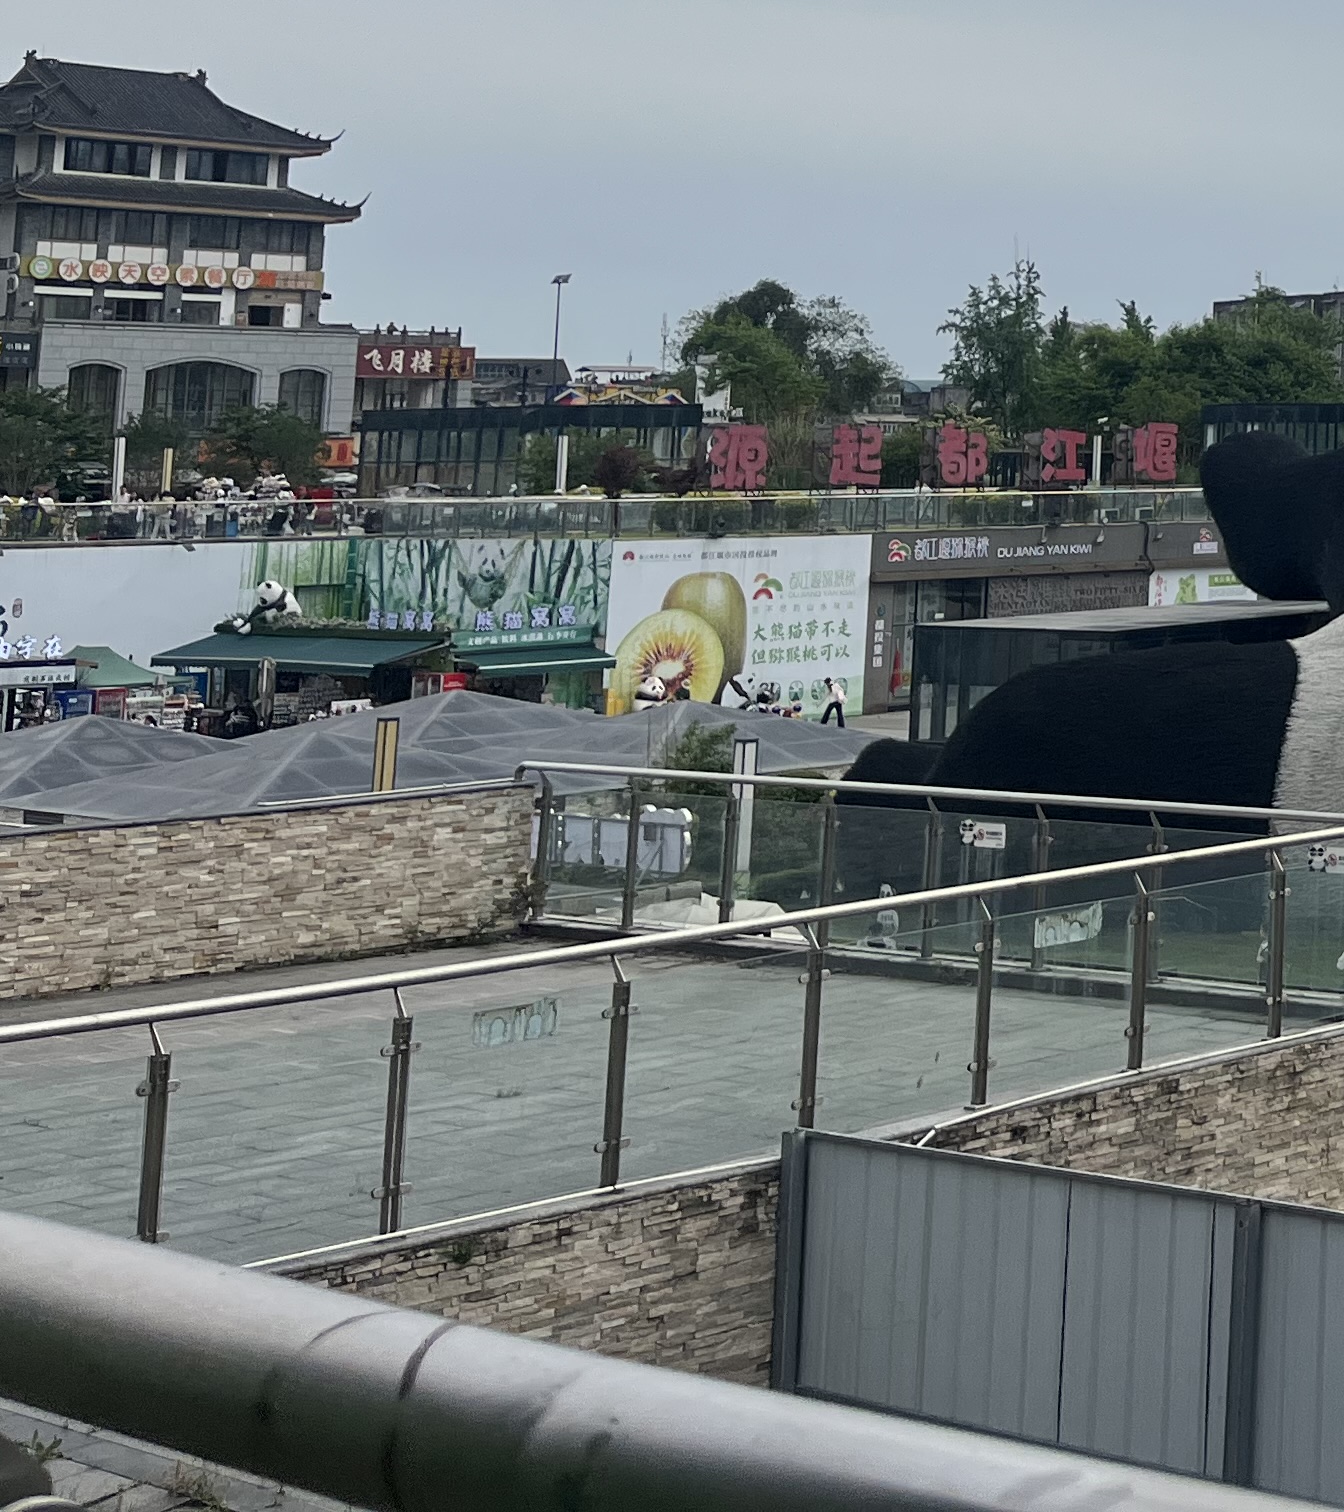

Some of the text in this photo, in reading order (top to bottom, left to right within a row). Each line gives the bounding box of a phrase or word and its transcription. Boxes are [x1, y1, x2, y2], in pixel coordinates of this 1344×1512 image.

[364, 349, 433, 374] 飞月楼
[710, 422, 1179, 489] 源起都江堰
[1047, 544, 1068, 555] YAN
[1069, 544, 1093, 554] KIWI
[475, 605, 576, 632] 熊猫窝窝
[752, 618, 852, 642] 大熊猫带不走
[751, 644, 850, 665] 但猕猴桃可以
